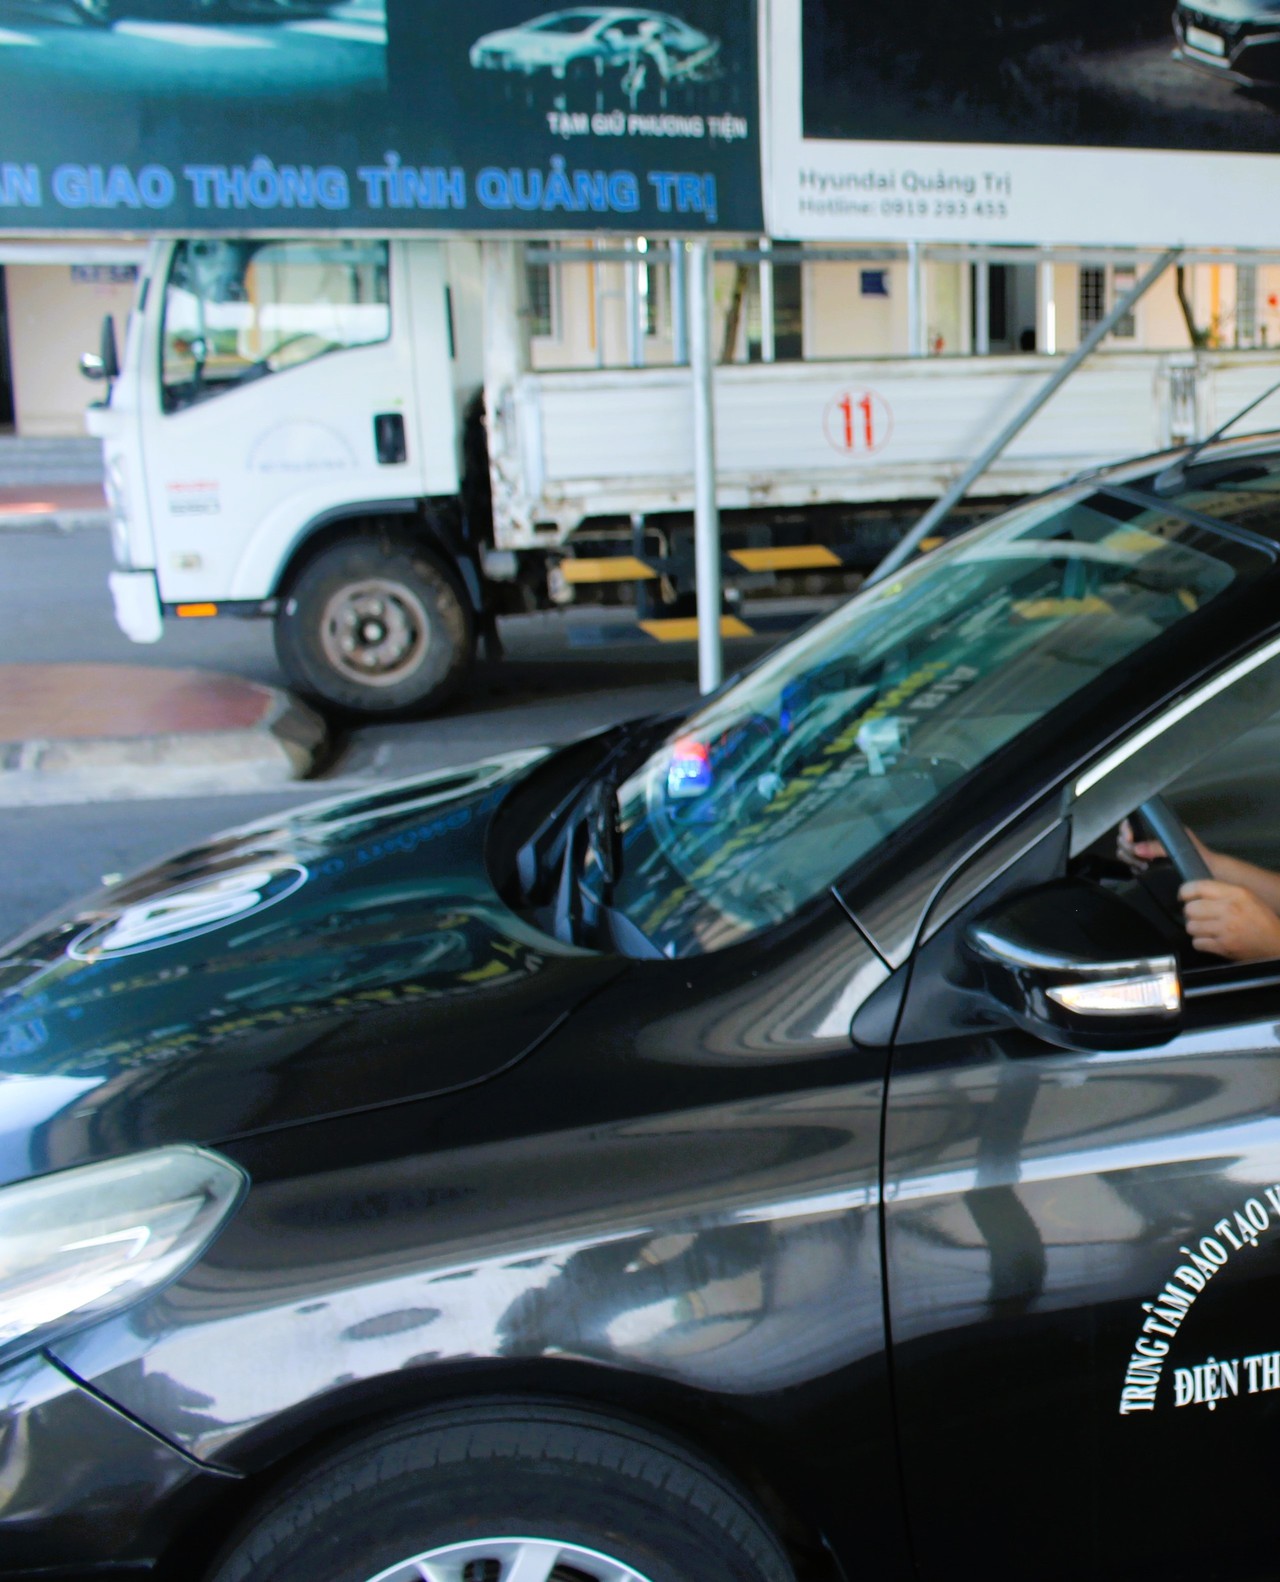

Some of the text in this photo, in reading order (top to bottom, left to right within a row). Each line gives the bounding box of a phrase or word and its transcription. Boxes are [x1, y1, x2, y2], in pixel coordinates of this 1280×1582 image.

[53, 164, 176, 209] GIAO
[183, 153, 349, 210] THÔNG
[356, 150, 467, 209] TỈNH
[476, 154, 640, 213] QUẢNG
[647, 171, 718, 223] TRỊ
[799, 166, 1012, 197] Hyundai Quảng Trị
[837, 392, 873, 451] 11
[1214, 1198, 1270, 1250] TẠO
[1173, 1236, 1228, 1293] ĐÀO
[1141, 1282, 1197, 1338] TÂM
[1119, 1336, 1170, 1415] TRUNG
[1173, 1356, 1240, 1411] ĐIỆN
